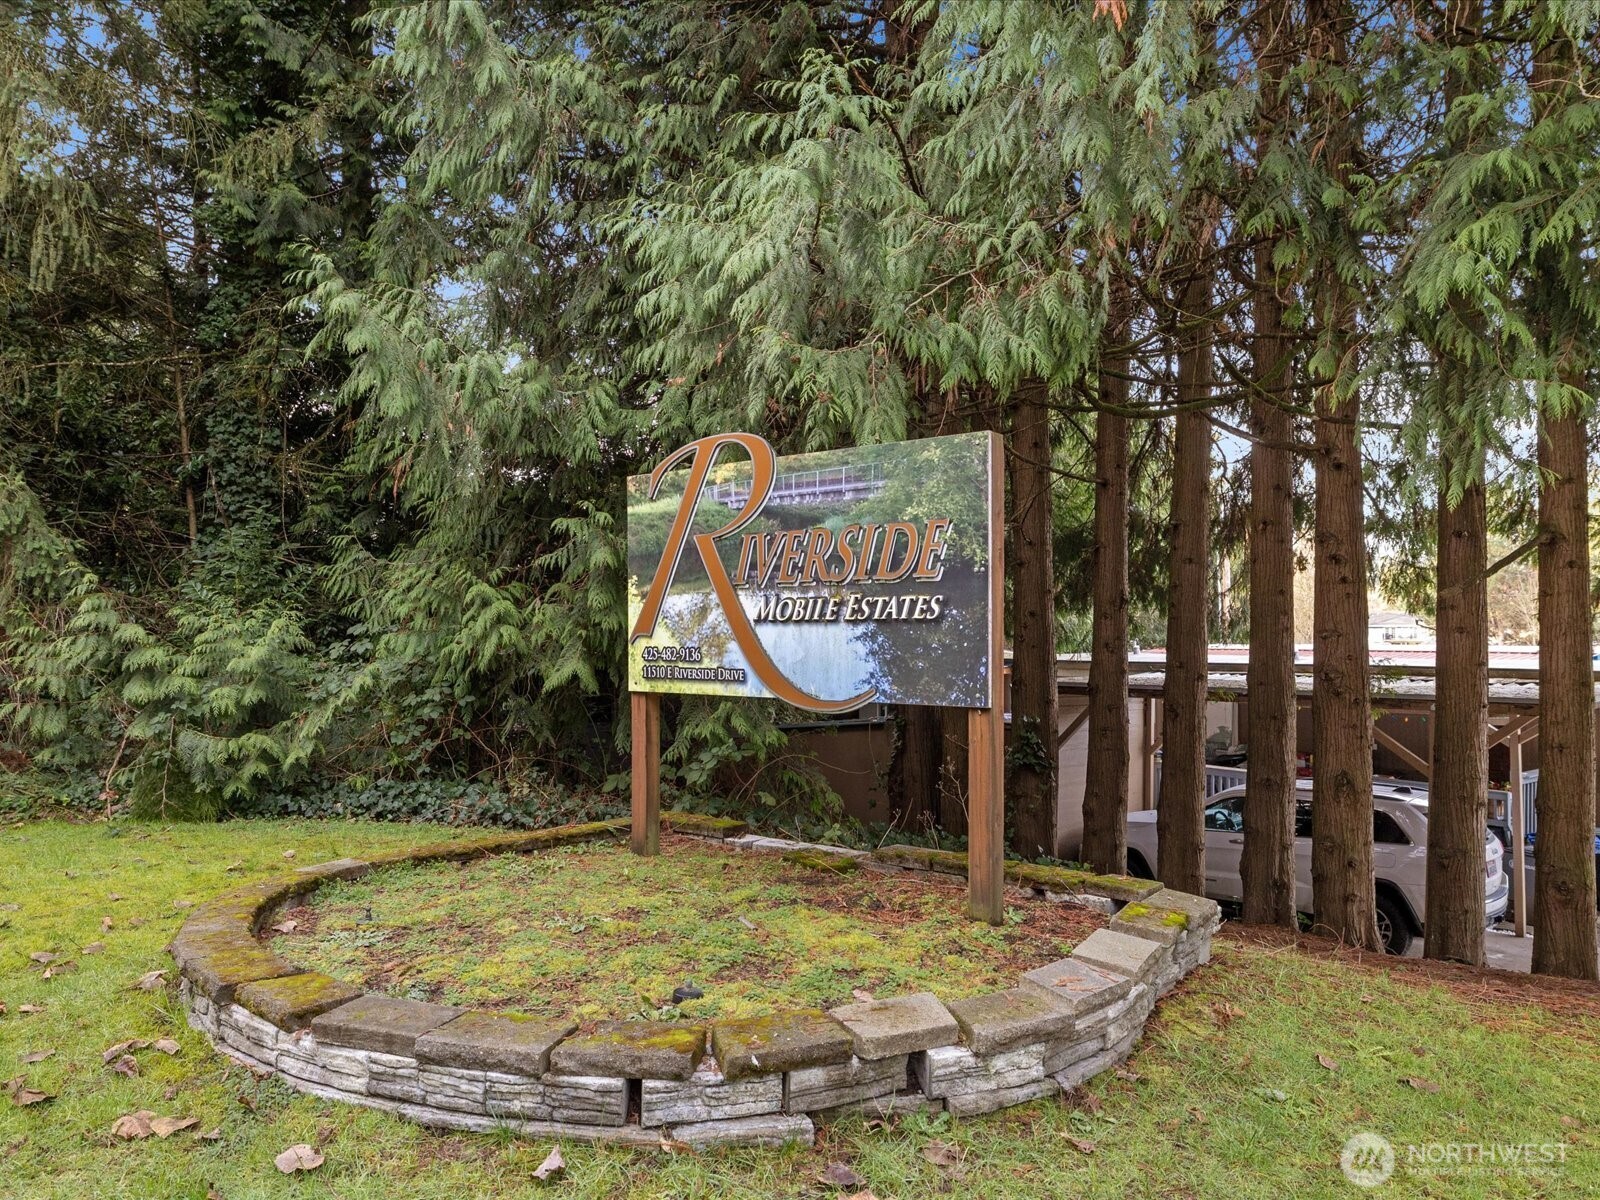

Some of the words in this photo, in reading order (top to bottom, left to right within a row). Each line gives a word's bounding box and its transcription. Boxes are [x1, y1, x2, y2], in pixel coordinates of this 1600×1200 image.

[630, 432, 954, 714] RIVERSIDE
[753, 596, 839, 621] MOBILE
[844, 594, 944, 621] ESTATES
[642, 647, 701, 661] 425-482-9136
[642, 665, 665, 678] 11510
[667, 667, 673, 679] E
[674, 668, 716, 680] RIVERSIDE
[718, 668, 745, 681] DRIVE
